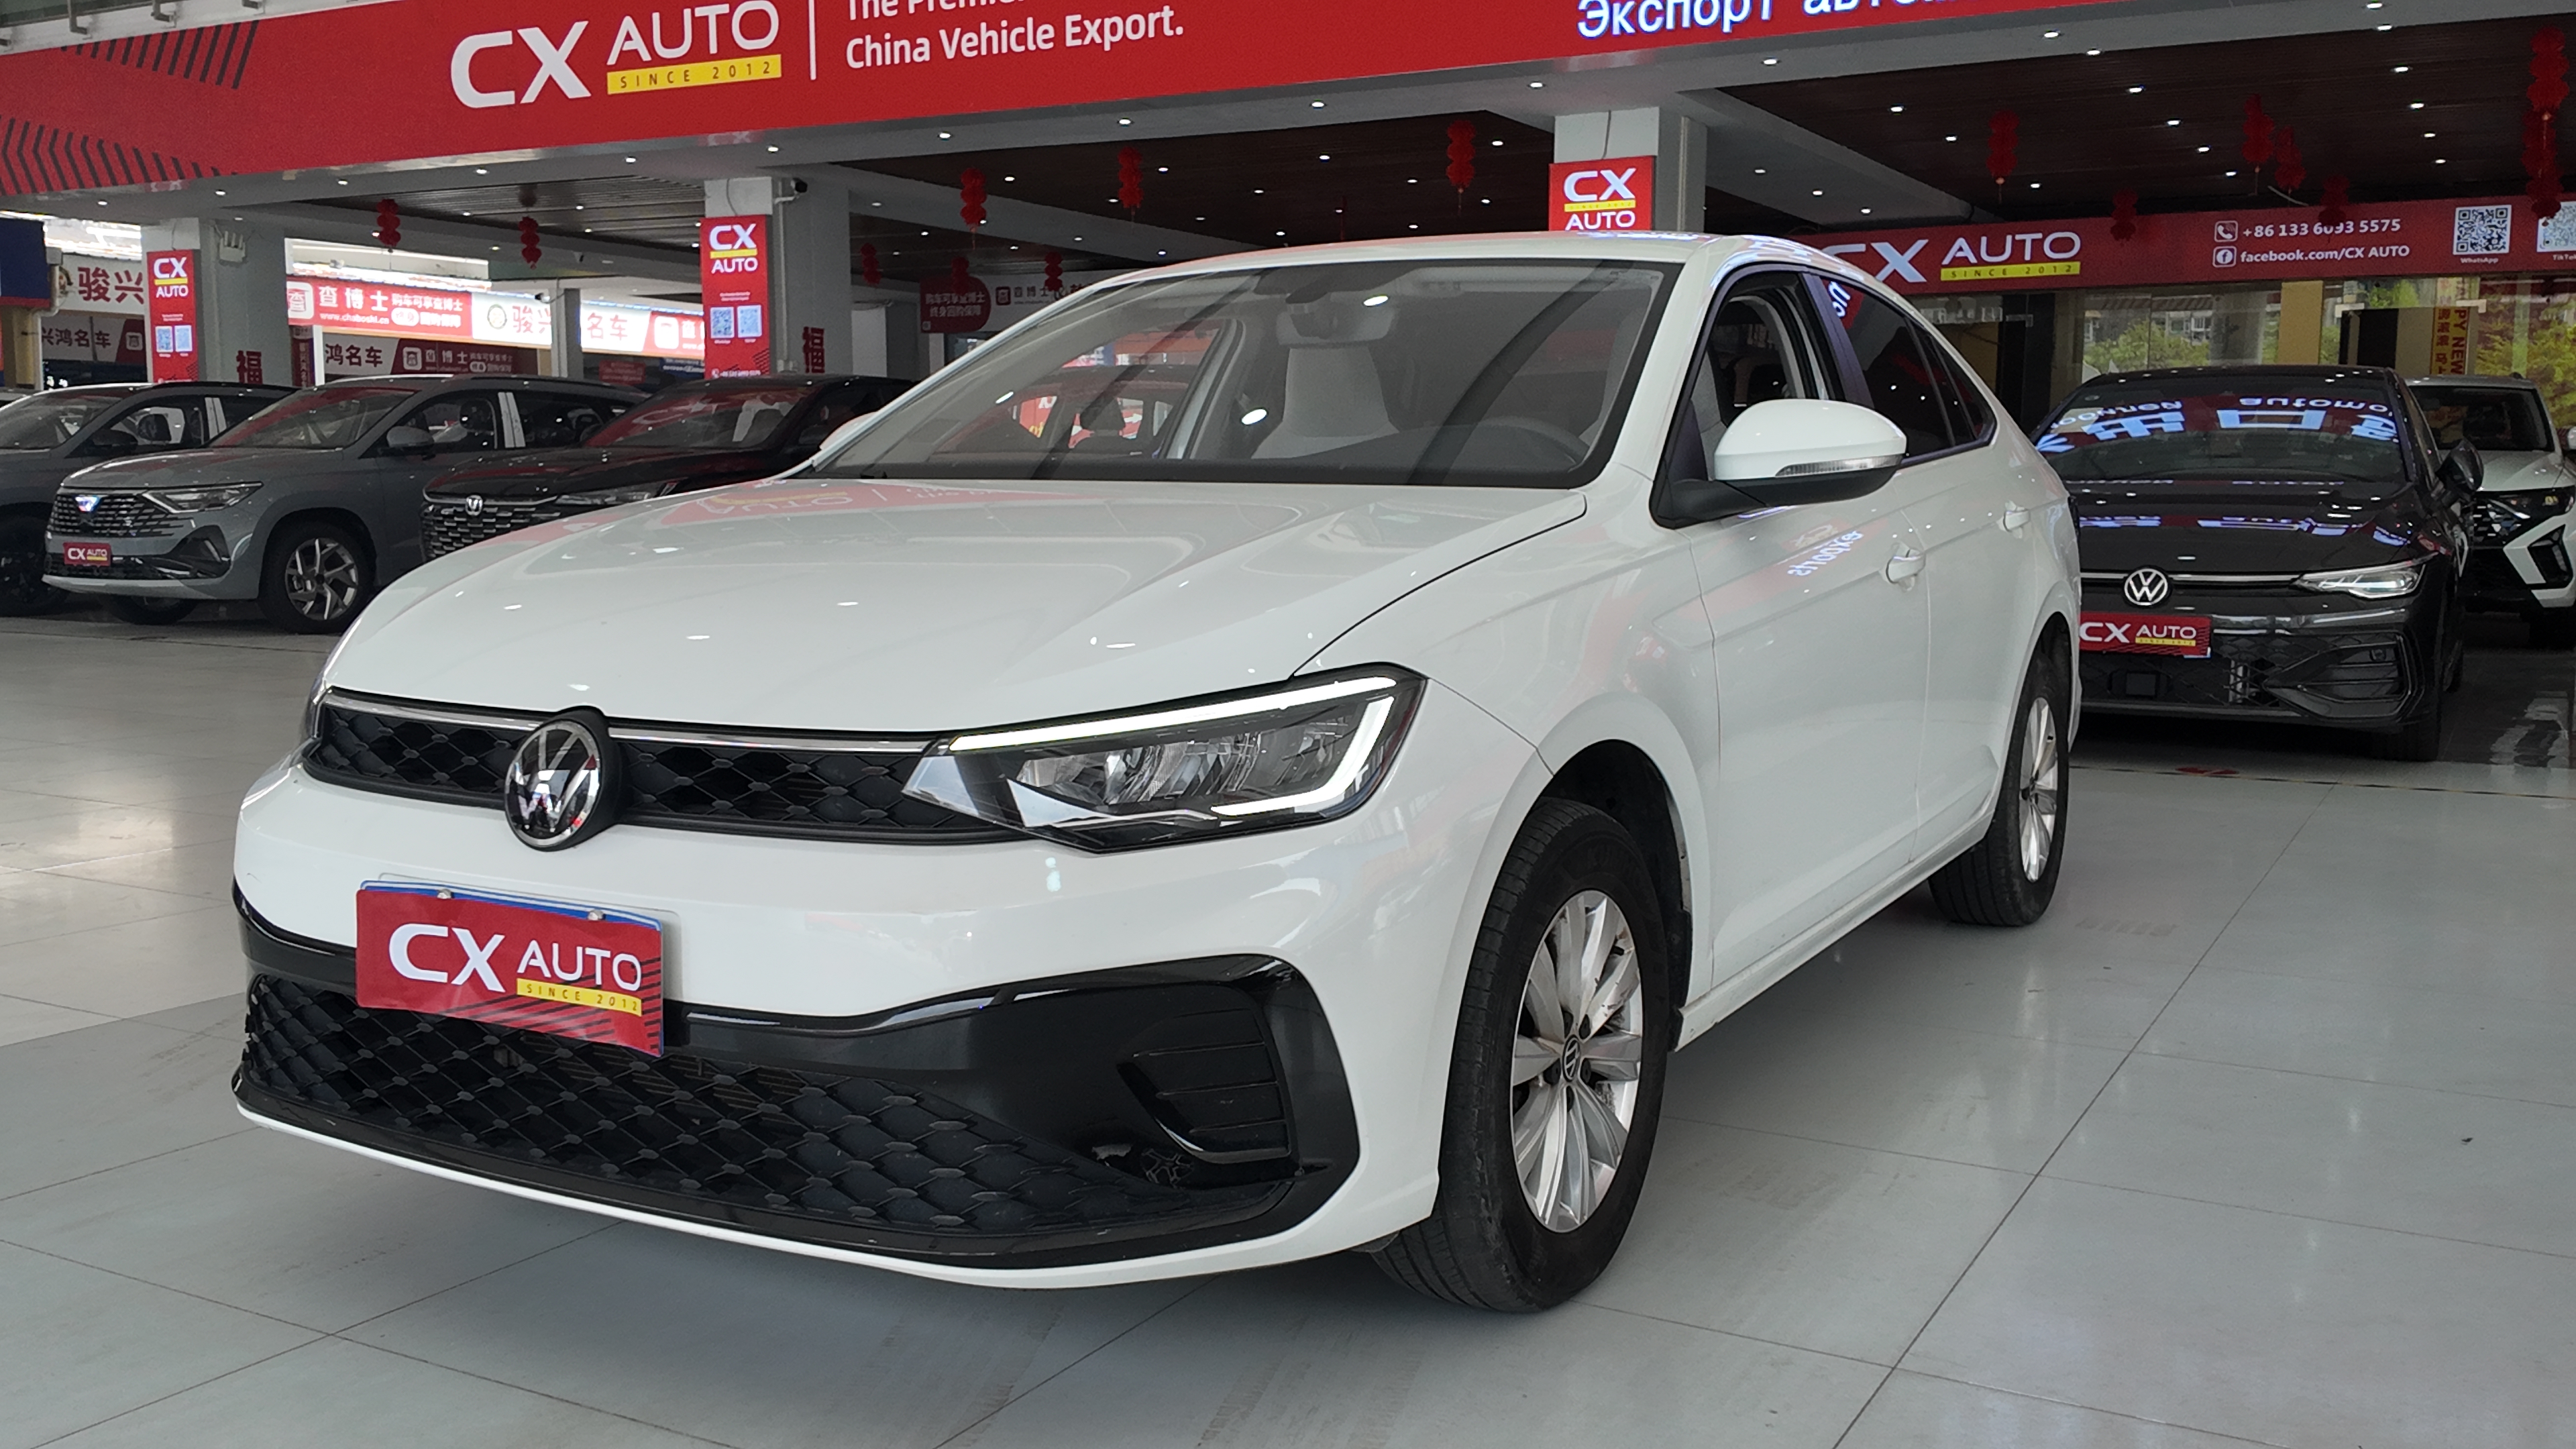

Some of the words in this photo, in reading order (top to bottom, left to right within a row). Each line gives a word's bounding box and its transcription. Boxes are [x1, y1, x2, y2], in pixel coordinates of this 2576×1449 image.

[846, 33, 930, 68] China
[939, 17, 1055, 59] Vehicle
[1065, 5, 1184, 51] Export.
[451, 21, 592, 108] CX
[606, 0, 780, 65] AUTO
[620, 69, 690, 89] SINCE
[712, 61, 771, 79] 2012
[1564, 168, 1636, 201] CX
[1565, 210, 1635, 231] AUTO
[2243, 225, 2274, 237] +86
[2279, 223, 2309, 237] 133
[2359, 219, 2401, 233] 5575
[709, 223, 757, 250] CX
[1941, 231, 2080, 265] AUTO
[711, 257, 758, 274] AUTO
[2241, 247, 2364, 262] facebook.com/CX
[2368, 246, 2410, 258] AUTO
[154, 257, 187, 279] CX
[1951, 268, 2008, 278] SINCE
[2025, 265, 2073, 274] 2012
[77, 266, 144, 305] 骏兴
[156, 285, 189, 298] AUTO
[319, 286, 389, 311] 查博士
[236, 350, 263, 384] 福
[325, 343, 383, 367] 鸿名车
[68, 547, 86, 559] CX
[2080, 621, 2131, 643] CX
[2136, 625, 2196, 639] AUTO
[388, 923, 506, 994] CX
[517, 940, 642, 991] AUTO
[527, 983, 580, 1002] SINCE
[596, 994, 639, 1012] 2012
